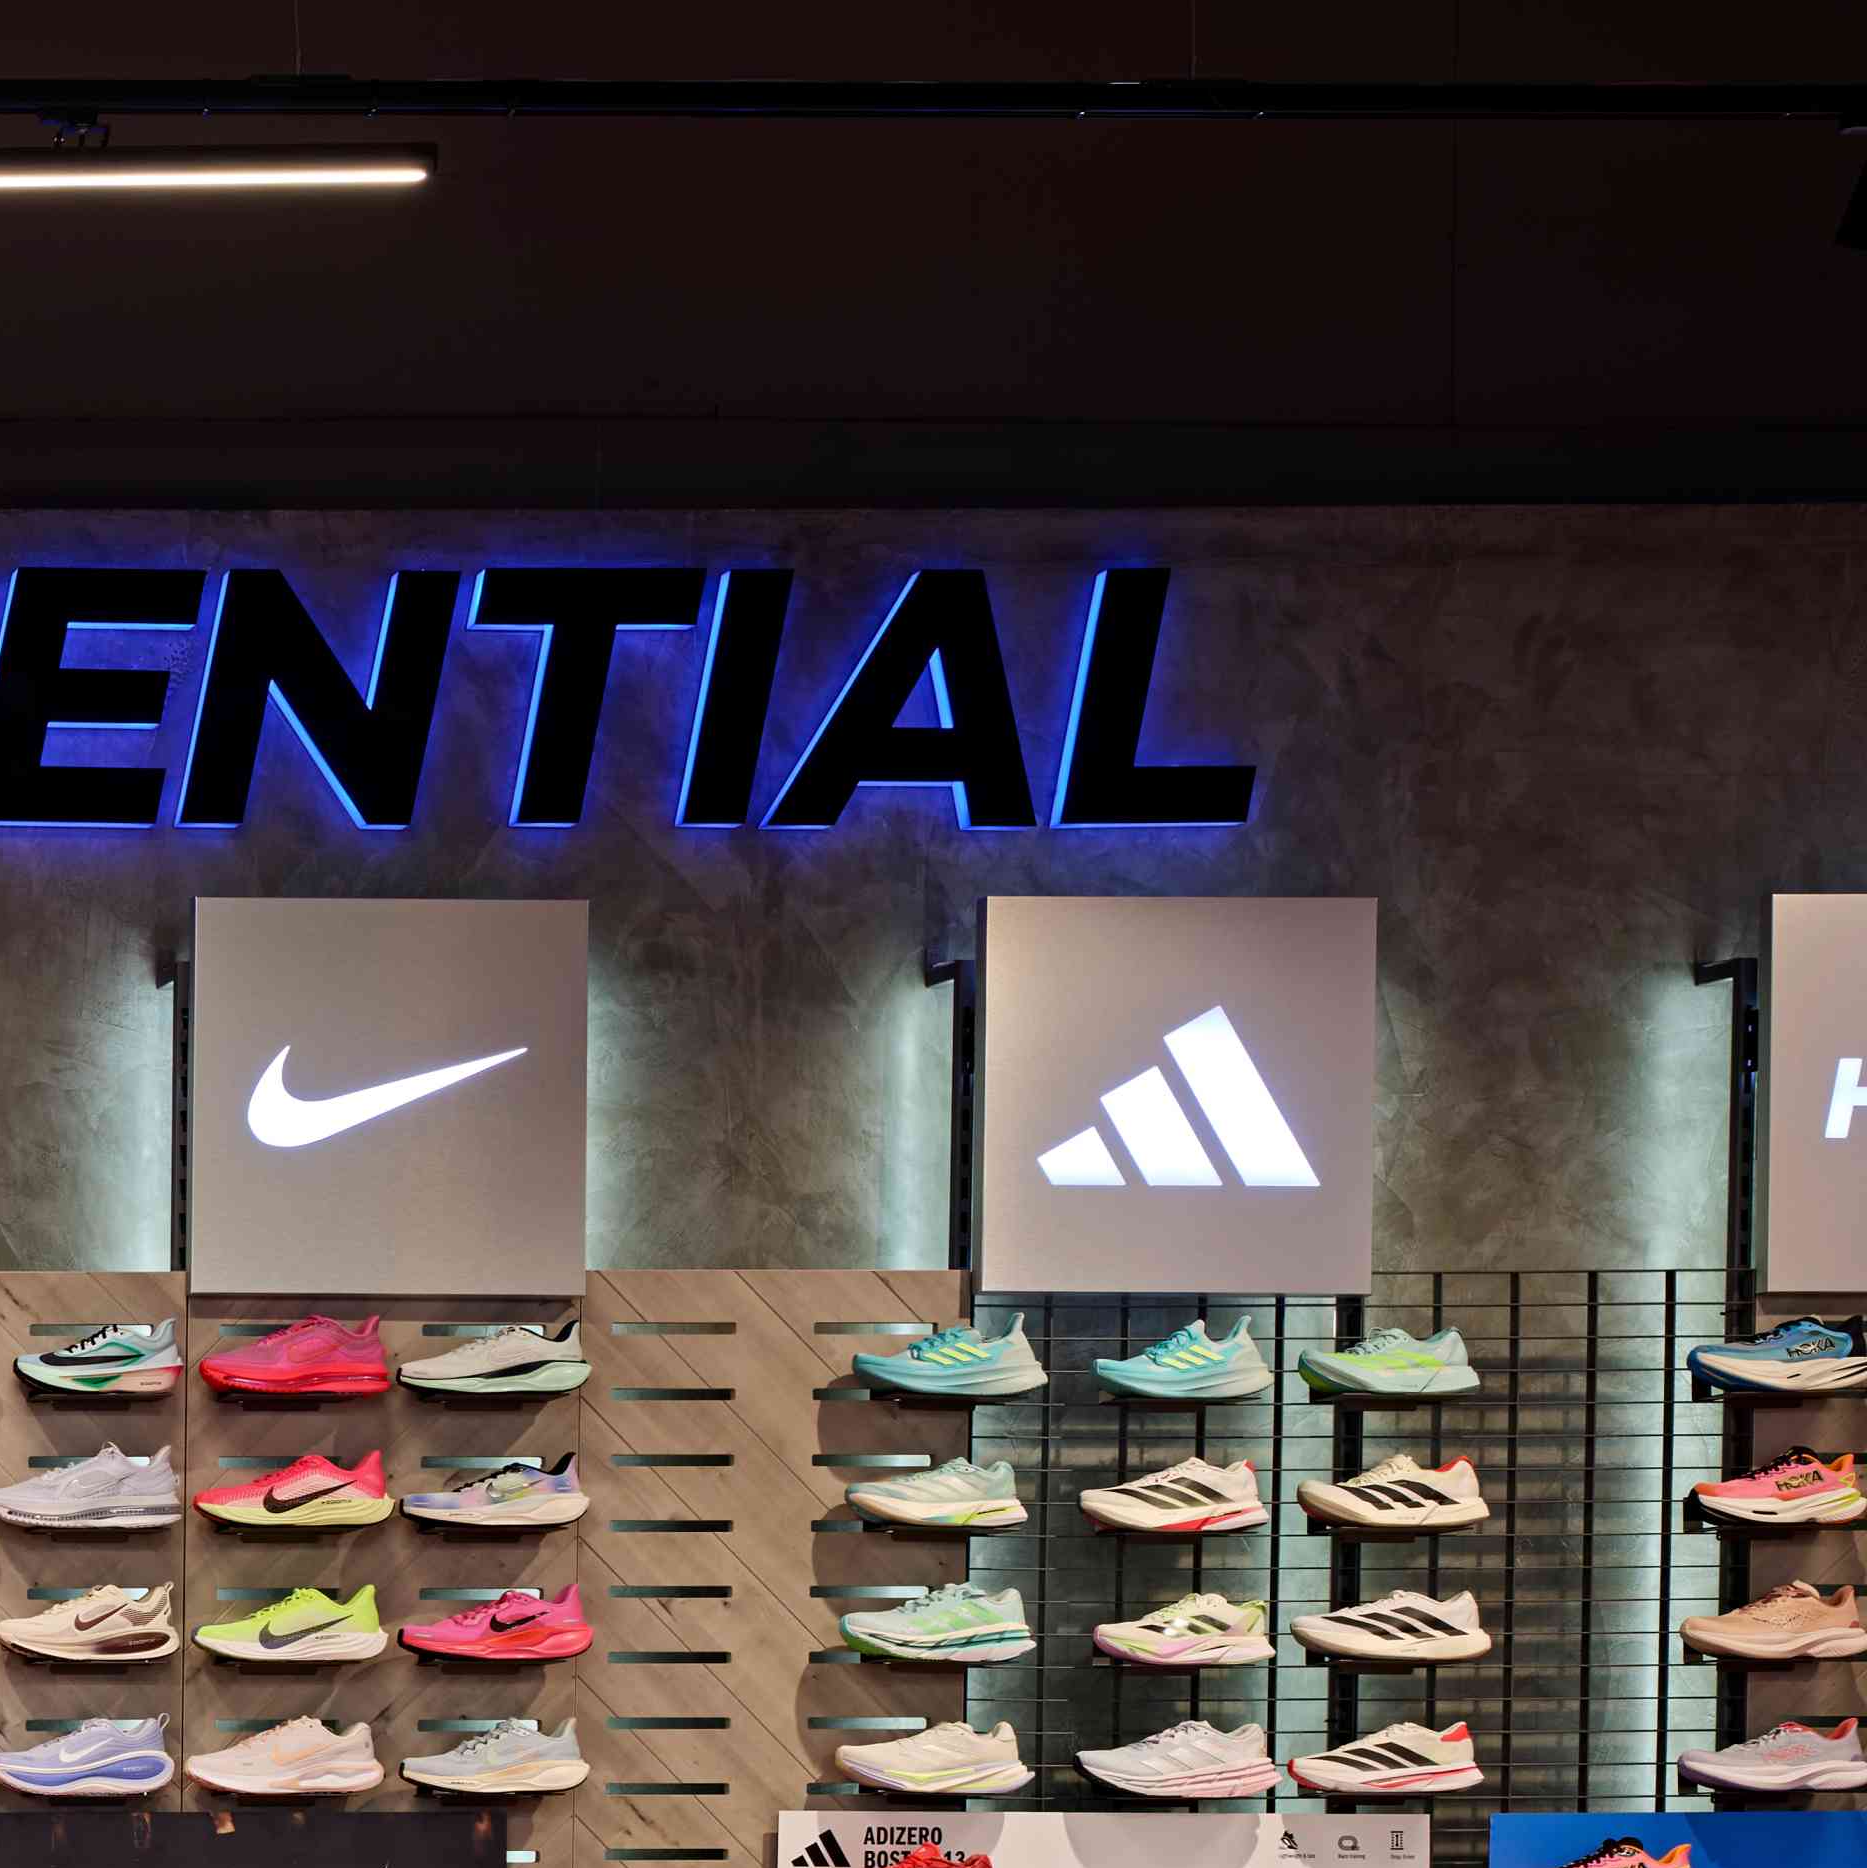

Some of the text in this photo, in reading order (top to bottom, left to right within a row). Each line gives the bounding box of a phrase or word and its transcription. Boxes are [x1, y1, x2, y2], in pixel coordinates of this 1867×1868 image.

[1786, 1337, 1836, 1359] HOKA
[1775, 1469, 1823, 1492] HOKA
[863, 1826, 942, 1845] ADIZERO
